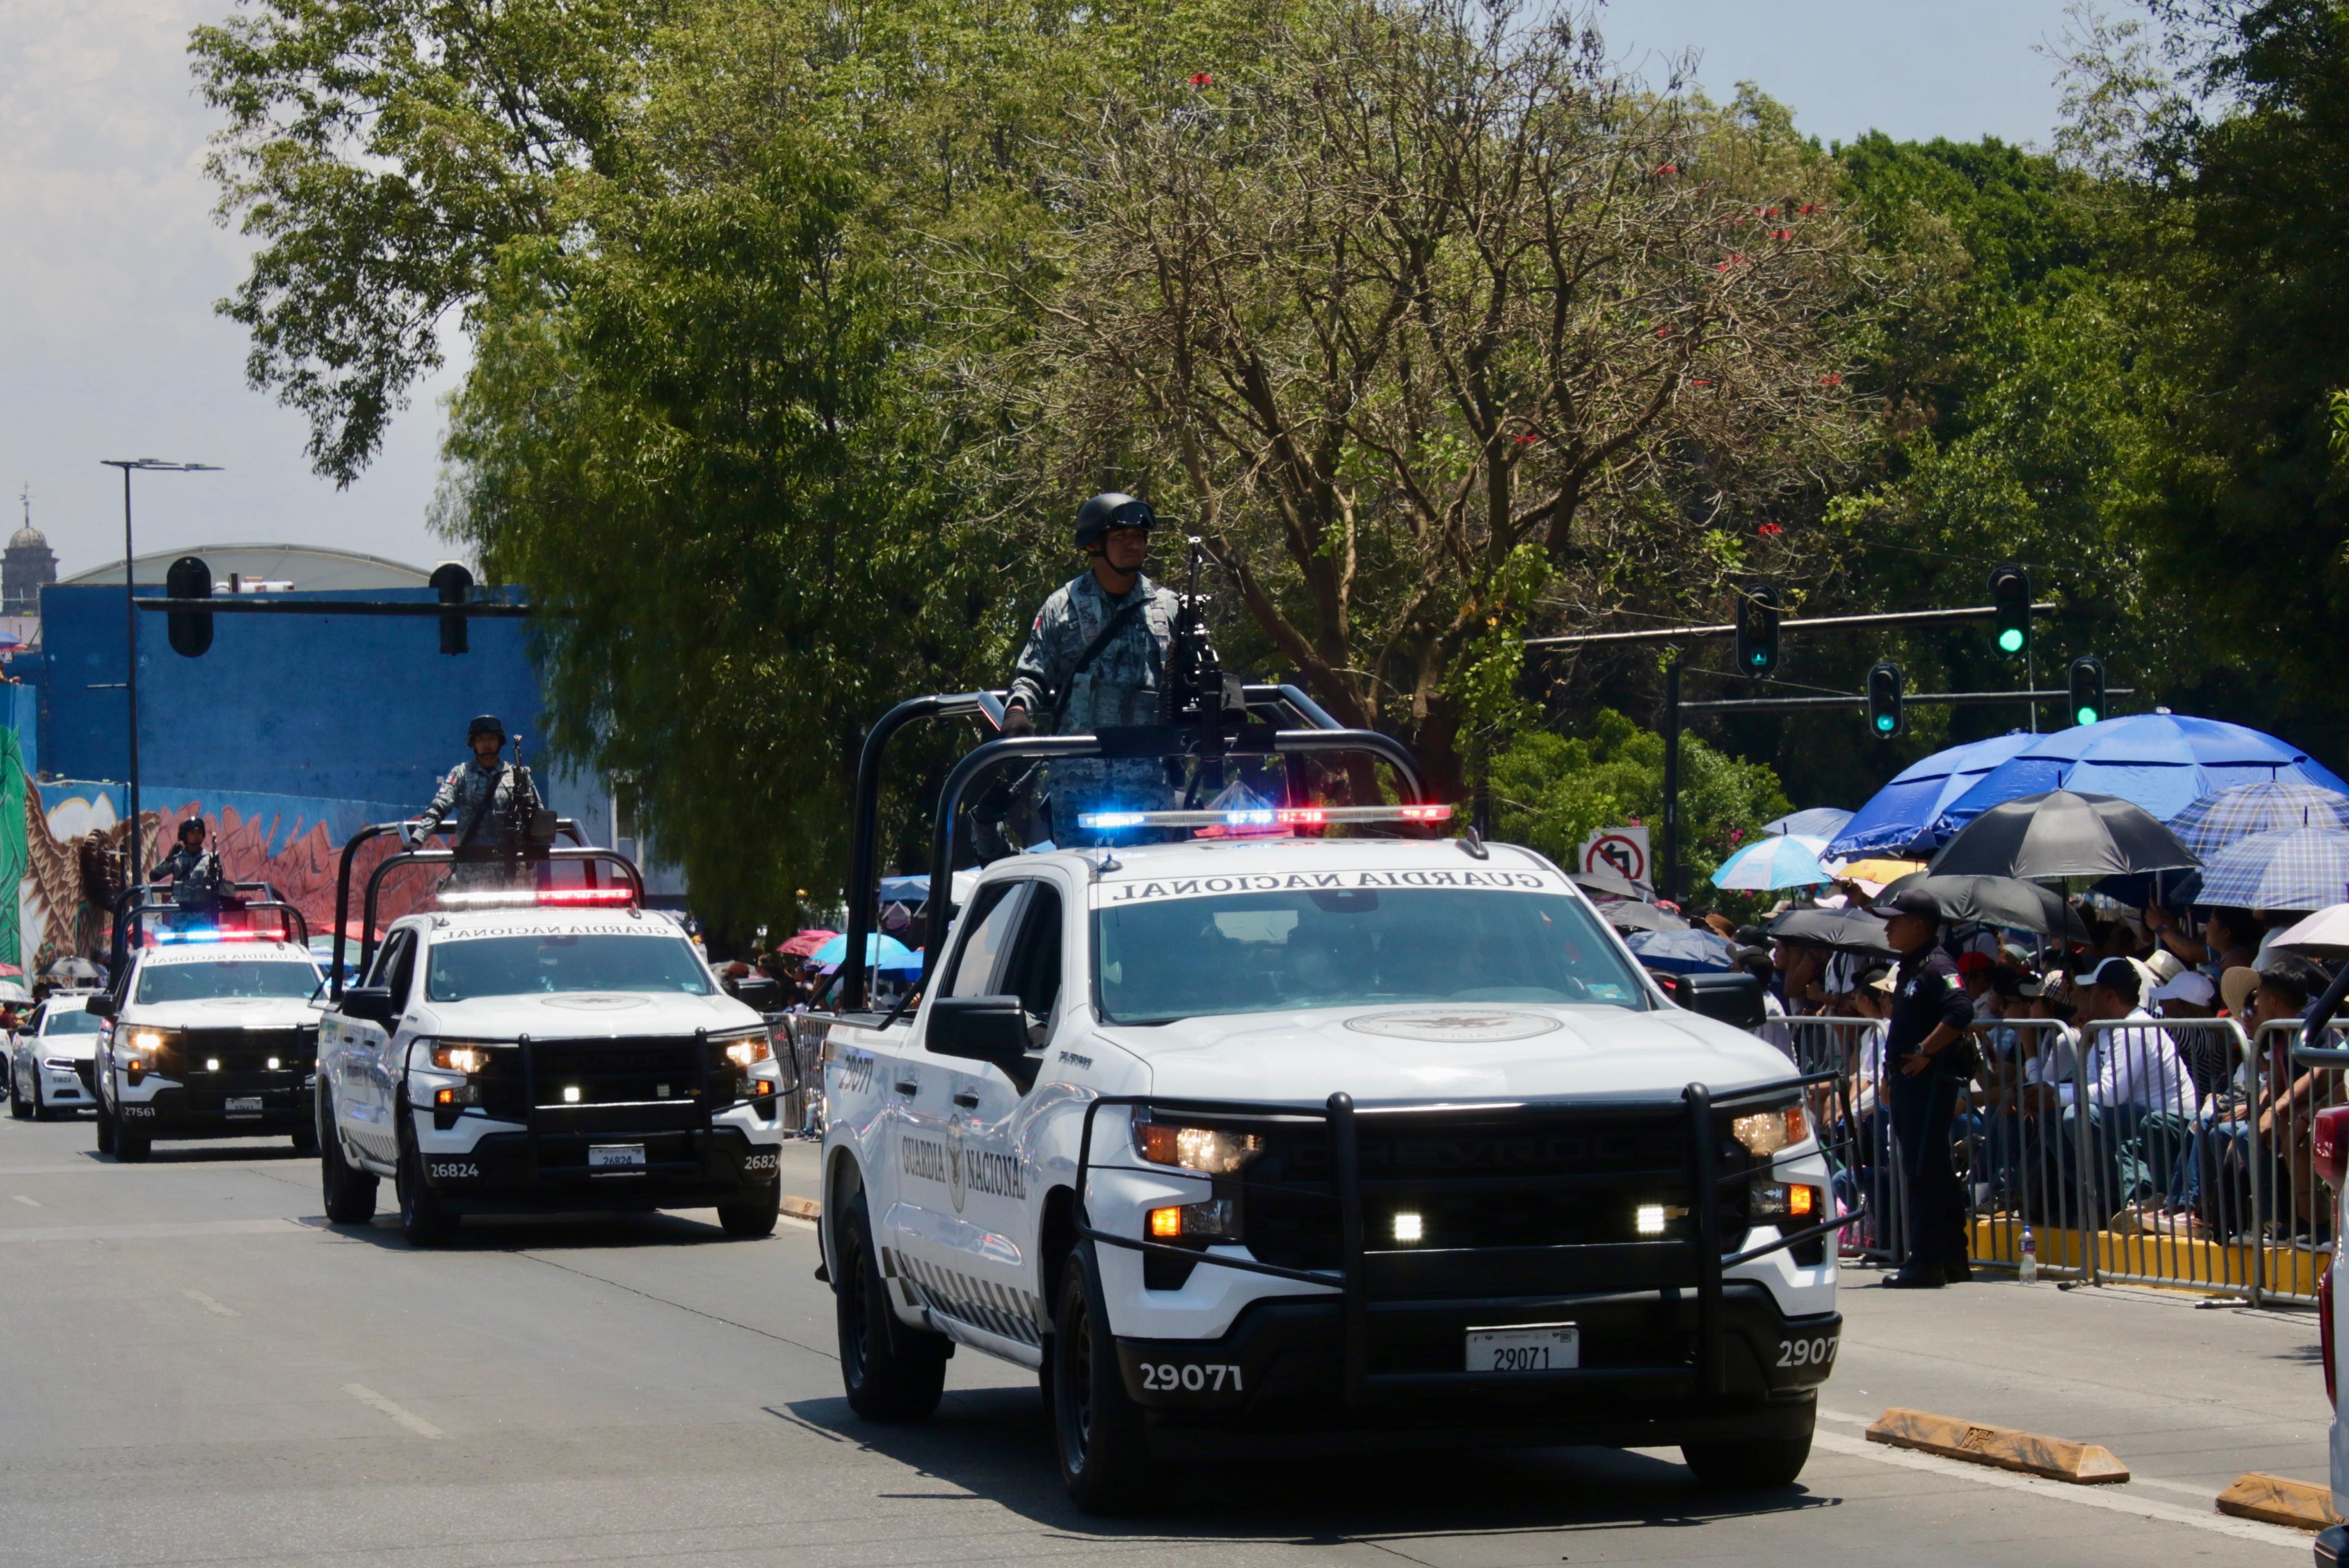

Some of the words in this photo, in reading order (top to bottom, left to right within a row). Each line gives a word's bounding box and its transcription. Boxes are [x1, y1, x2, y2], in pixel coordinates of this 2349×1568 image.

[838, 1054, 874, 1094] 29071
[125, 1107, 156, 1116] 27561
[431, 1163, 479, 1177] 26824
[903, 1135, 946, 1183] GUARDIA
[967, 1150, 1026, 1200] NACIONAL
[1494, 1346, 1549, 1371] 29071
[1140, 1363, 1242, 1391] 29071
